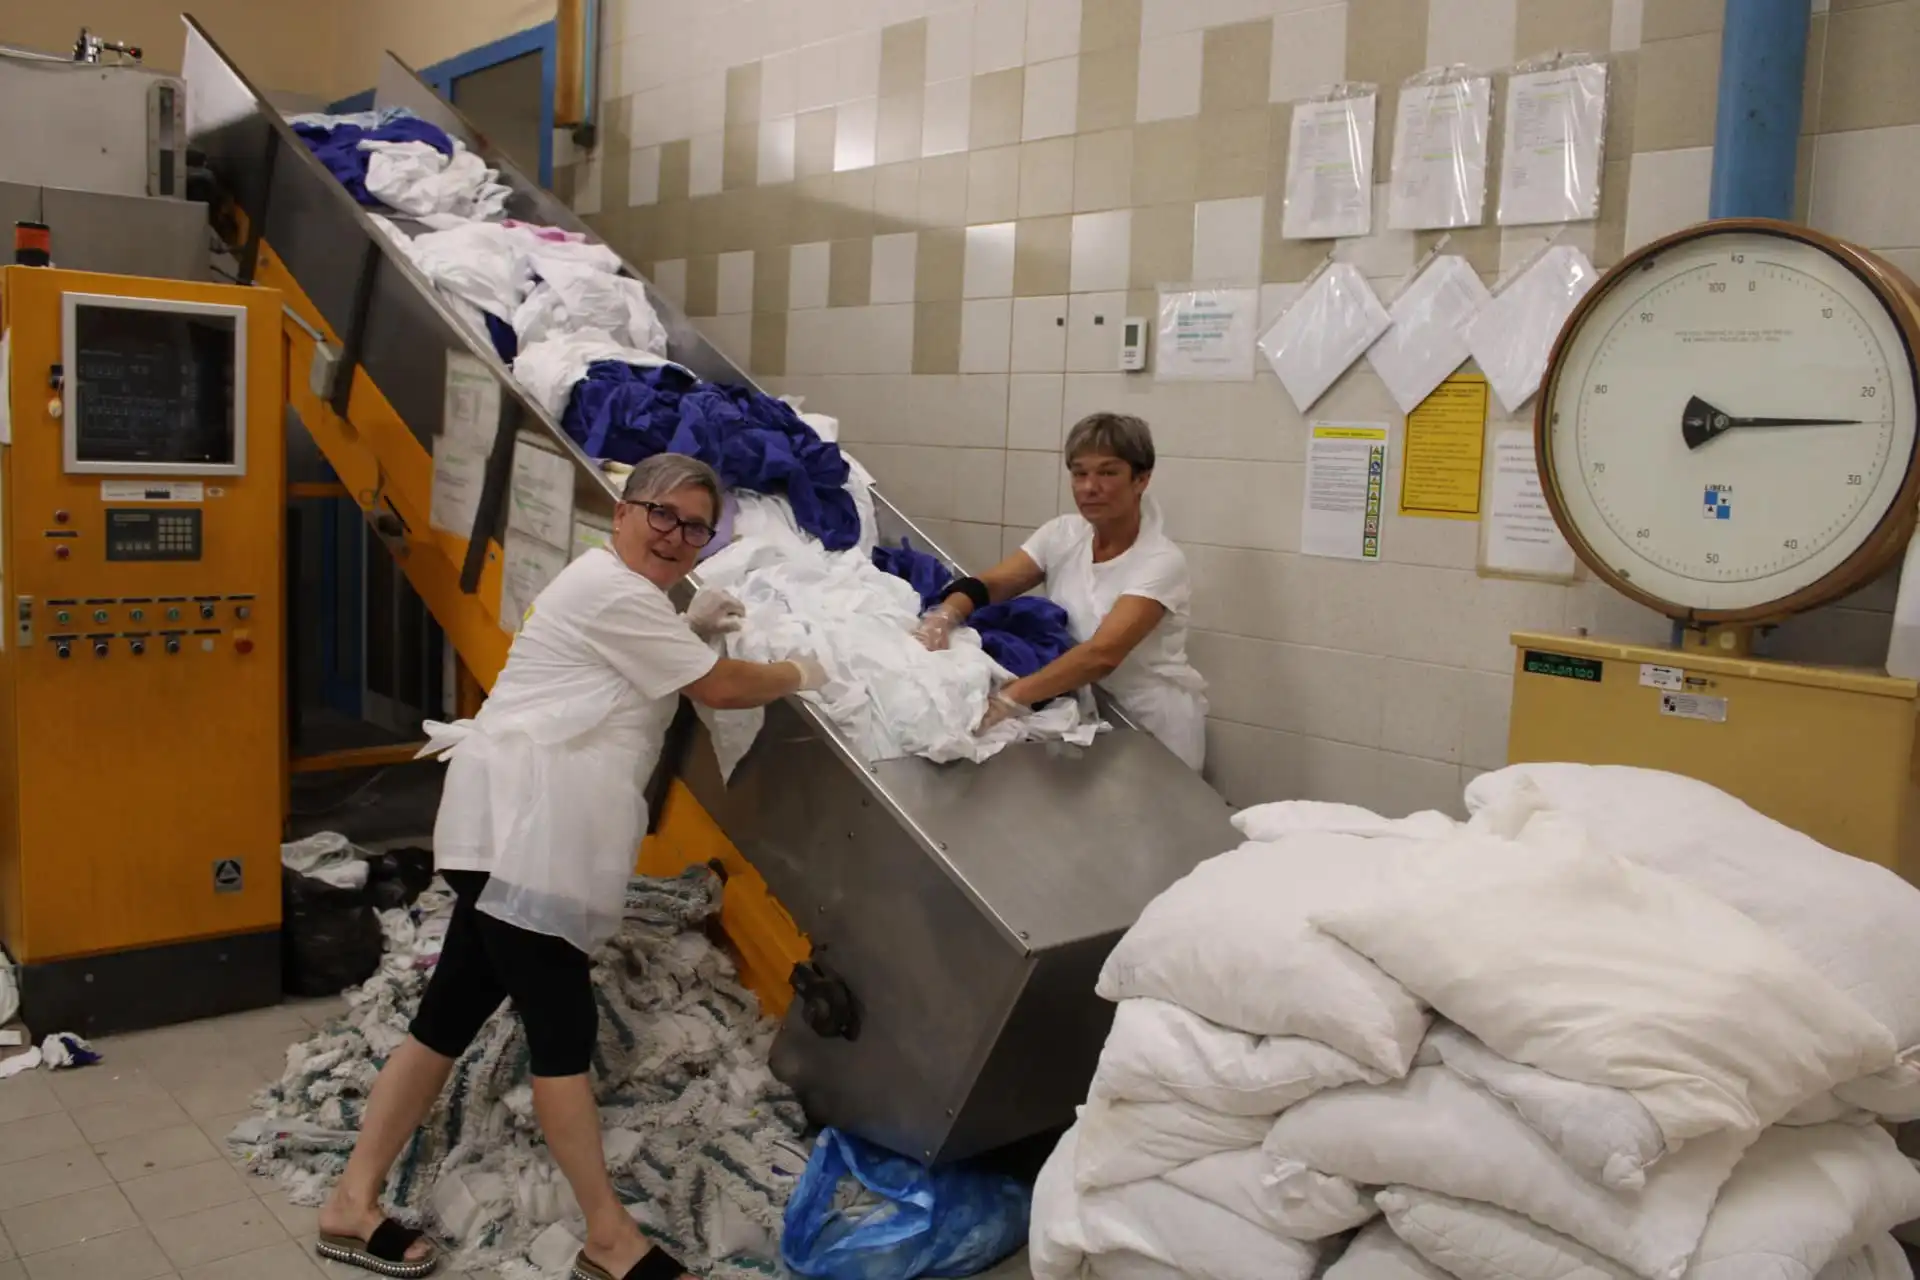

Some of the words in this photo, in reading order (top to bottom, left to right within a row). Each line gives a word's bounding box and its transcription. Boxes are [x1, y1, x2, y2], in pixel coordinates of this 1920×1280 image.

[1730, 252, 1744, 264] kg
[1708, 282, 1727, 293] 100
[1748, 280, 1756, 292] 0
[1640, 312, 1654, 323] 90
[1821, 307, 1833, 319] 10
[1594, 384, 1608, 394] 80
[1861, 386, 1876, 398] 20
[1593, 463, 1606, 473] 70
[1846, 473, 1862, 485] 30
[1636, 529, 1650, 538] 60
[1783, 539, 1798, 549] 40
[1705, 553, 1719, 564] 50
